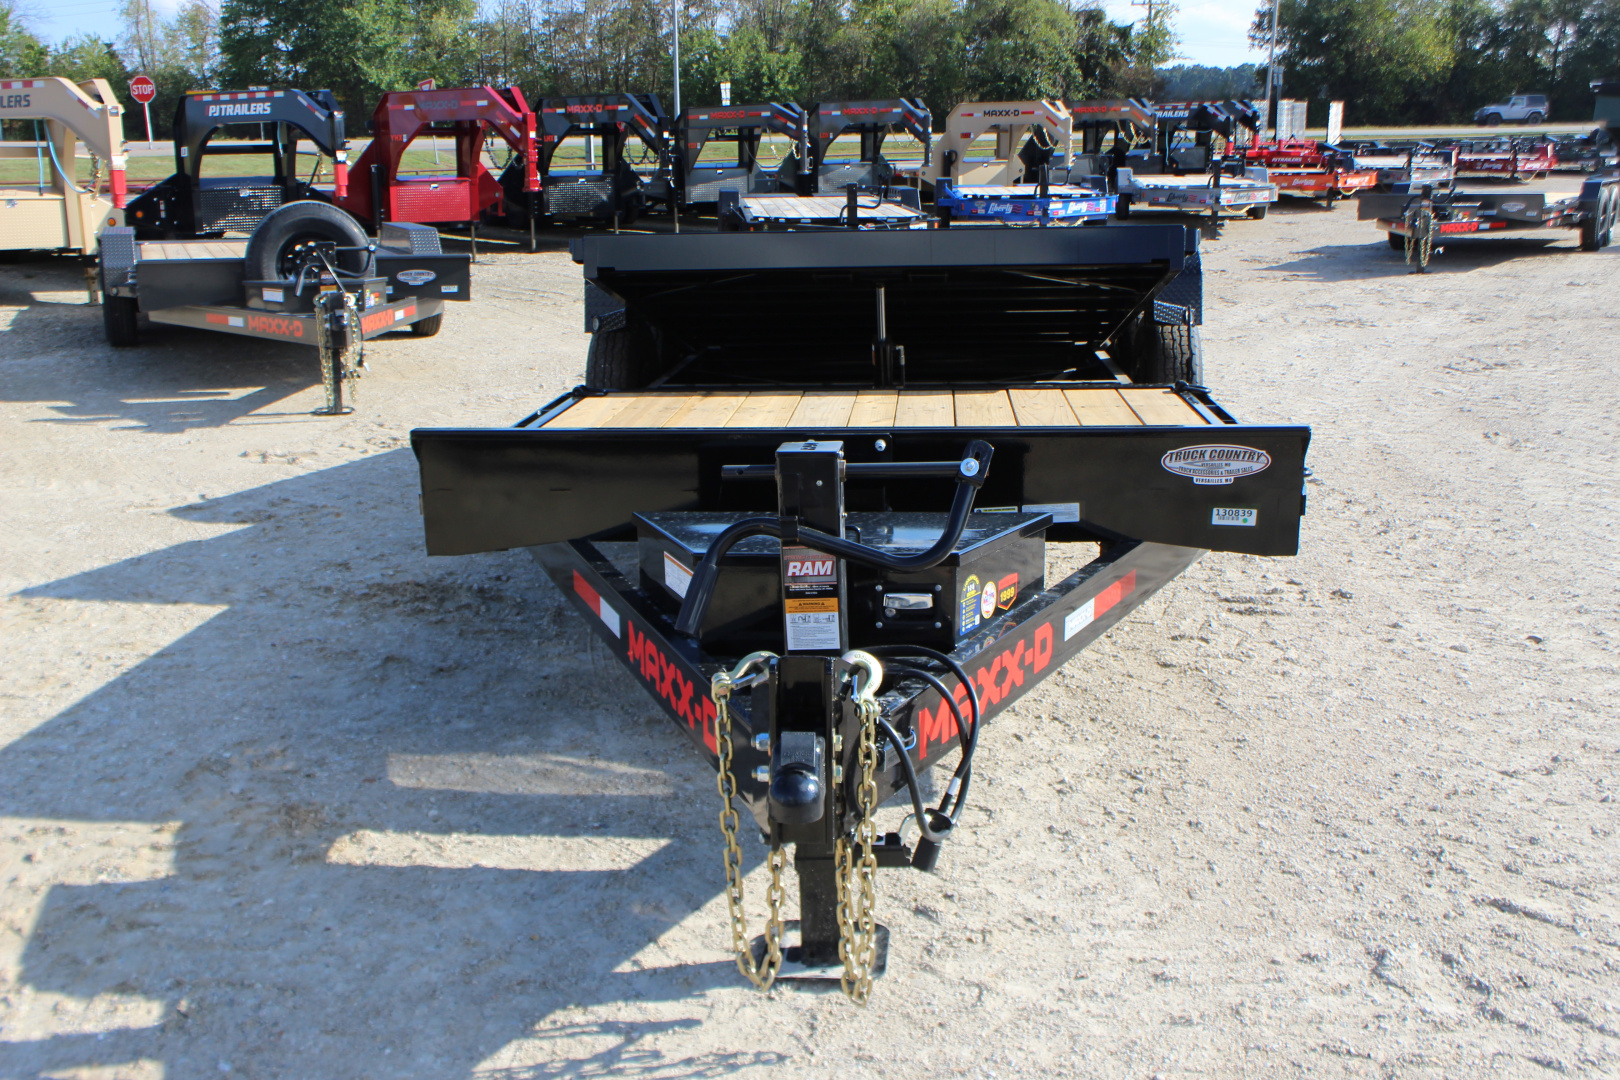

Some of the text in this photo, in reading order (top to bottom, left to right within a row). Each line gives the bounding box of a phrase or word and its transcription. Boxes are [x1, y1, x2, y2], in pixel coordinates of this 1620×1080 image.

[132, 84, 154, 95] STOP
[0, 94, 31, 108] LERS
[983, 109, 1020, 117] MAXX-D
[988, 202, 1013, 214] Liberty
[1440, 222, 1478, 233] MAXX-D
[247, 315, 303, 337] MAXX-D
[361, 308, 394, 335] MAXX-D
[1168, 449, 1264, 463] TRUCK COUNTRY
[1215, 509, 1253, 517] 130839
[787, 561, 833, 576] RAM
[1000, 586, 1015, 603] 1999
[627, 620, 717, 755] MAXX-D
[918, 621, 1053, 761] MAXX-D
